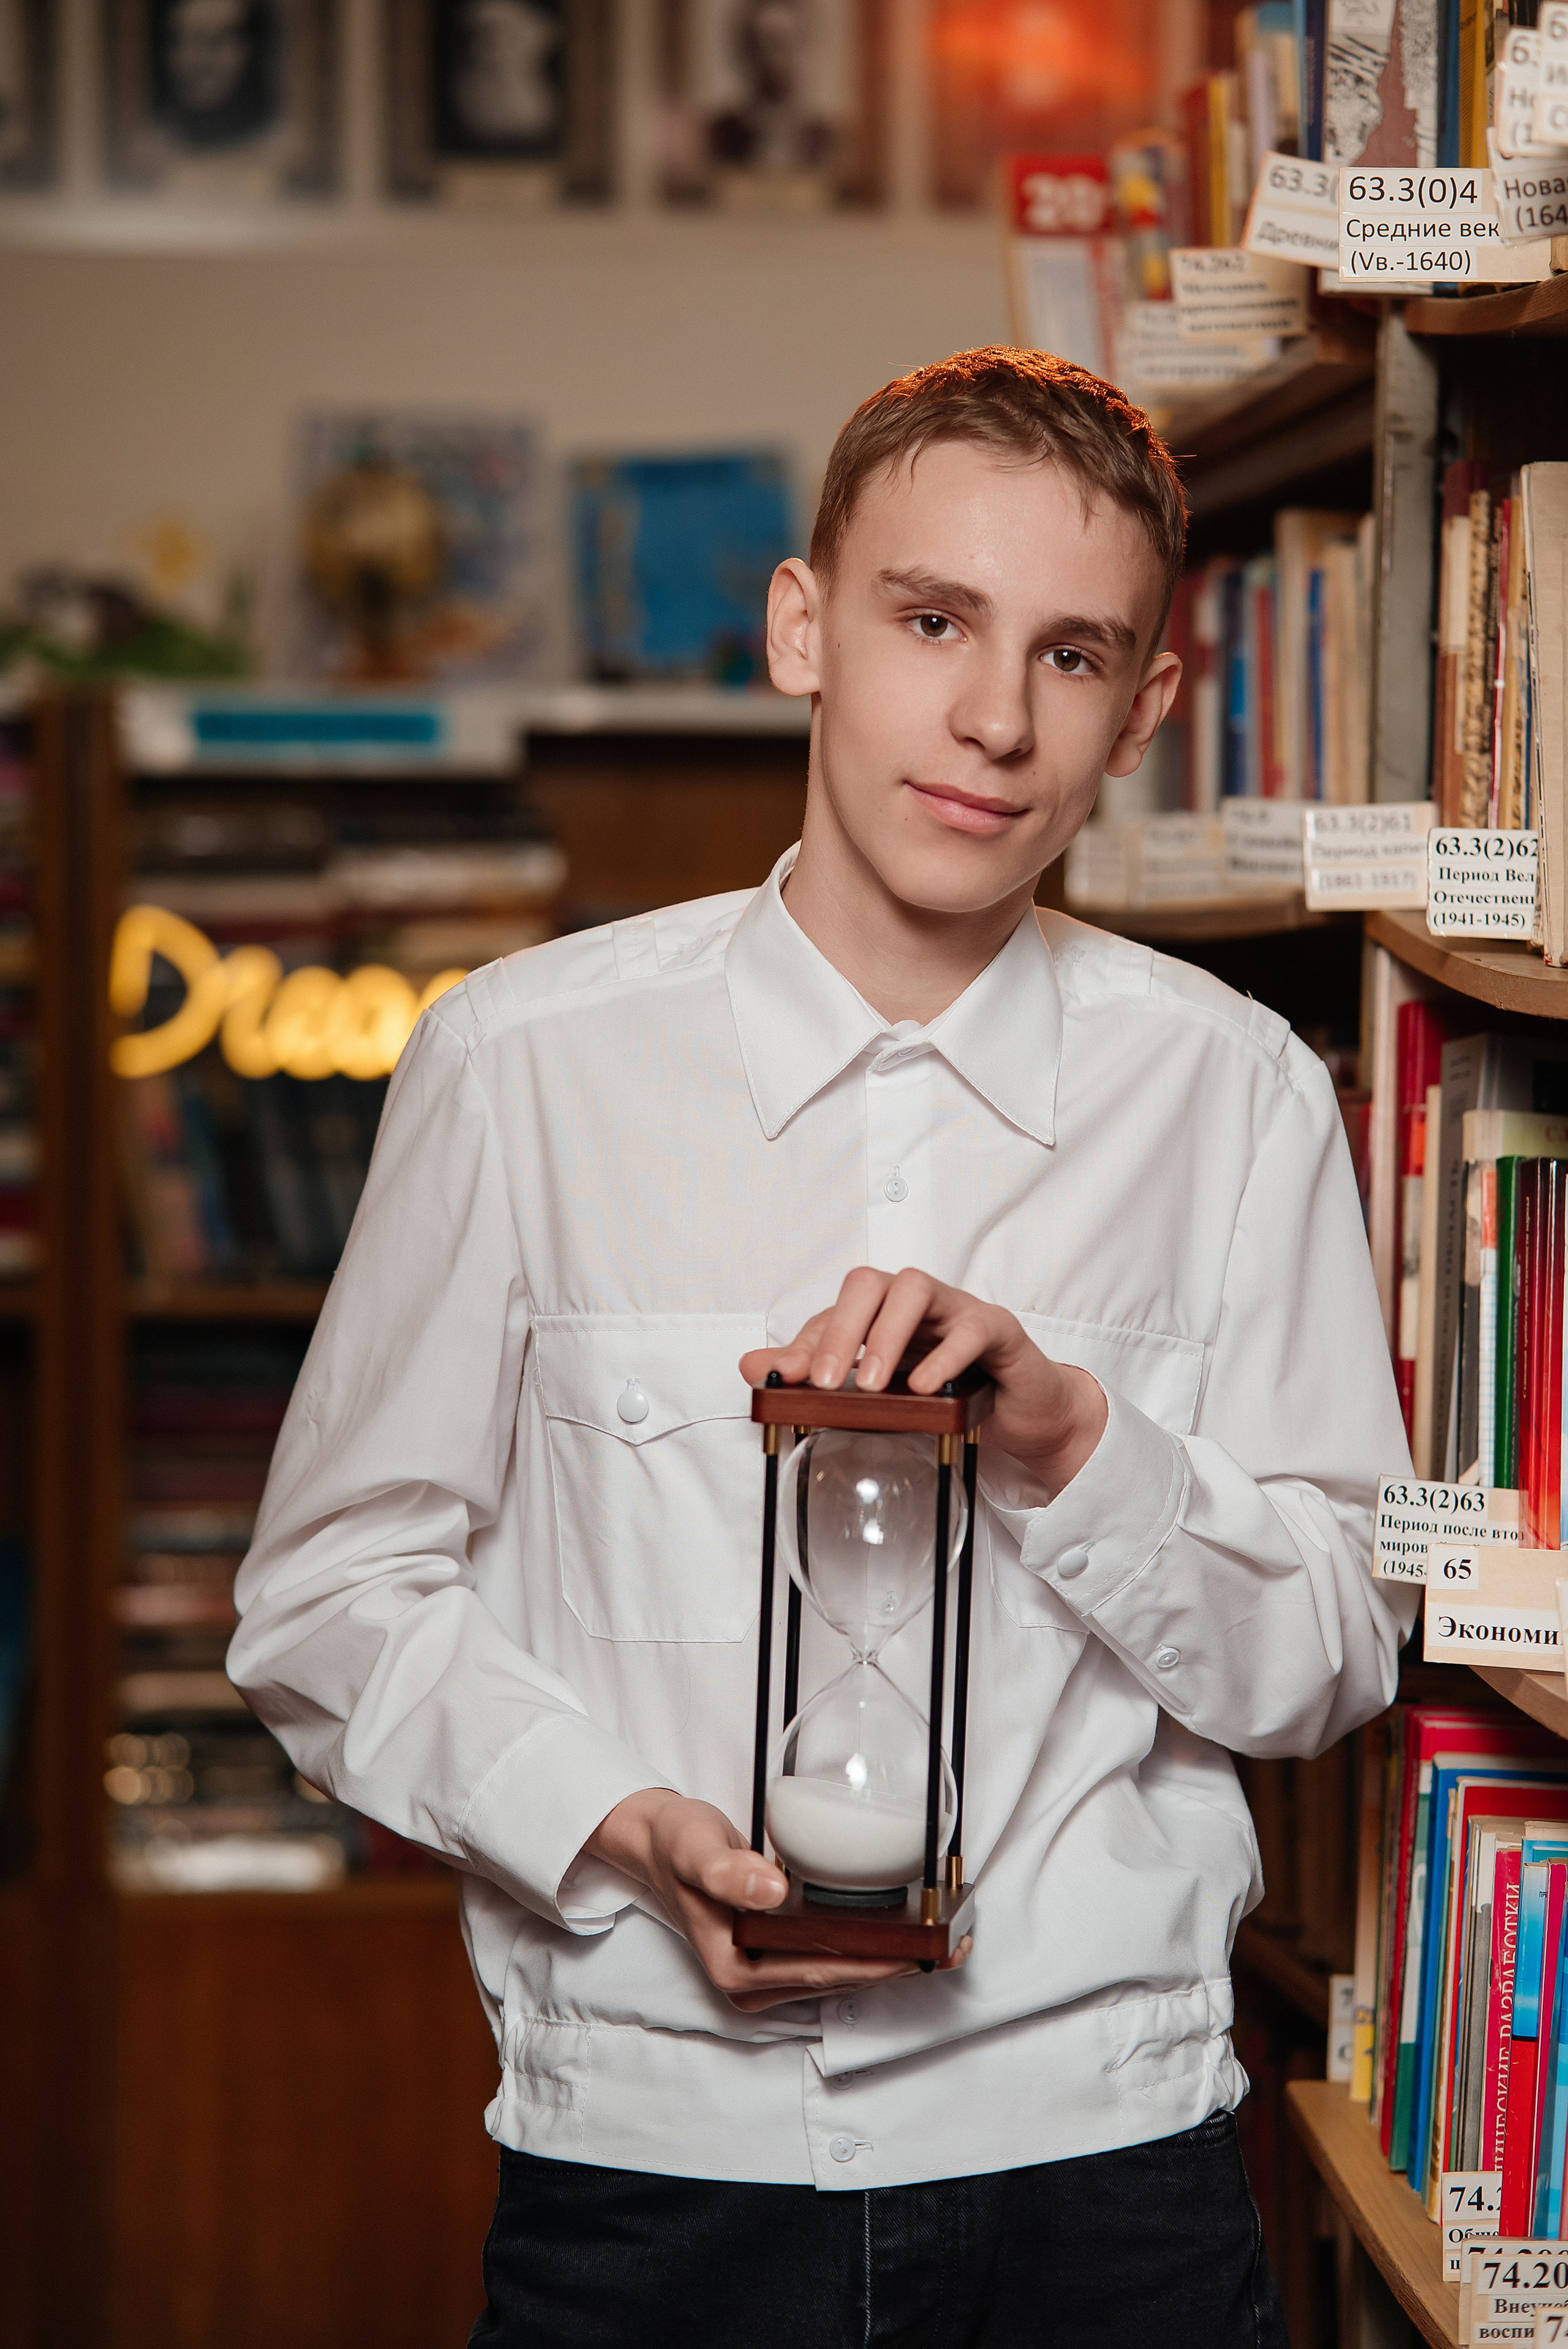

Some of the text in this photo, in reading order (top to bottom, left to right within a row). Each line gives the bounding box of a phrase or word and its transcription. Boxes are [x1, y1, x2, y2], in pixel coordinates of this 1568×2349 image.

[1349, 176, 1478, 209] 63.3(0)4
[1504, 177, 1568, 199] Нова
[1347, 219, 1499, 241] Средние век
[1351, 250, 1471, 275] (Vв.-1640)
[1439, 867, 1499, 883] Период
[1433, 911, 1525, 928] (1941-1945)
[1384, 1484, 1485, 1514] 63.3(2)63
[1380, 1514, 1438, 1534] Период
[1443, 1522, 1487, 1537] после
[1443, 1558, 1472, 1580] 65
[1438, 1616, 1563, 1646] Экономи
[1483, 2261, 1568, 2290] 74.20
